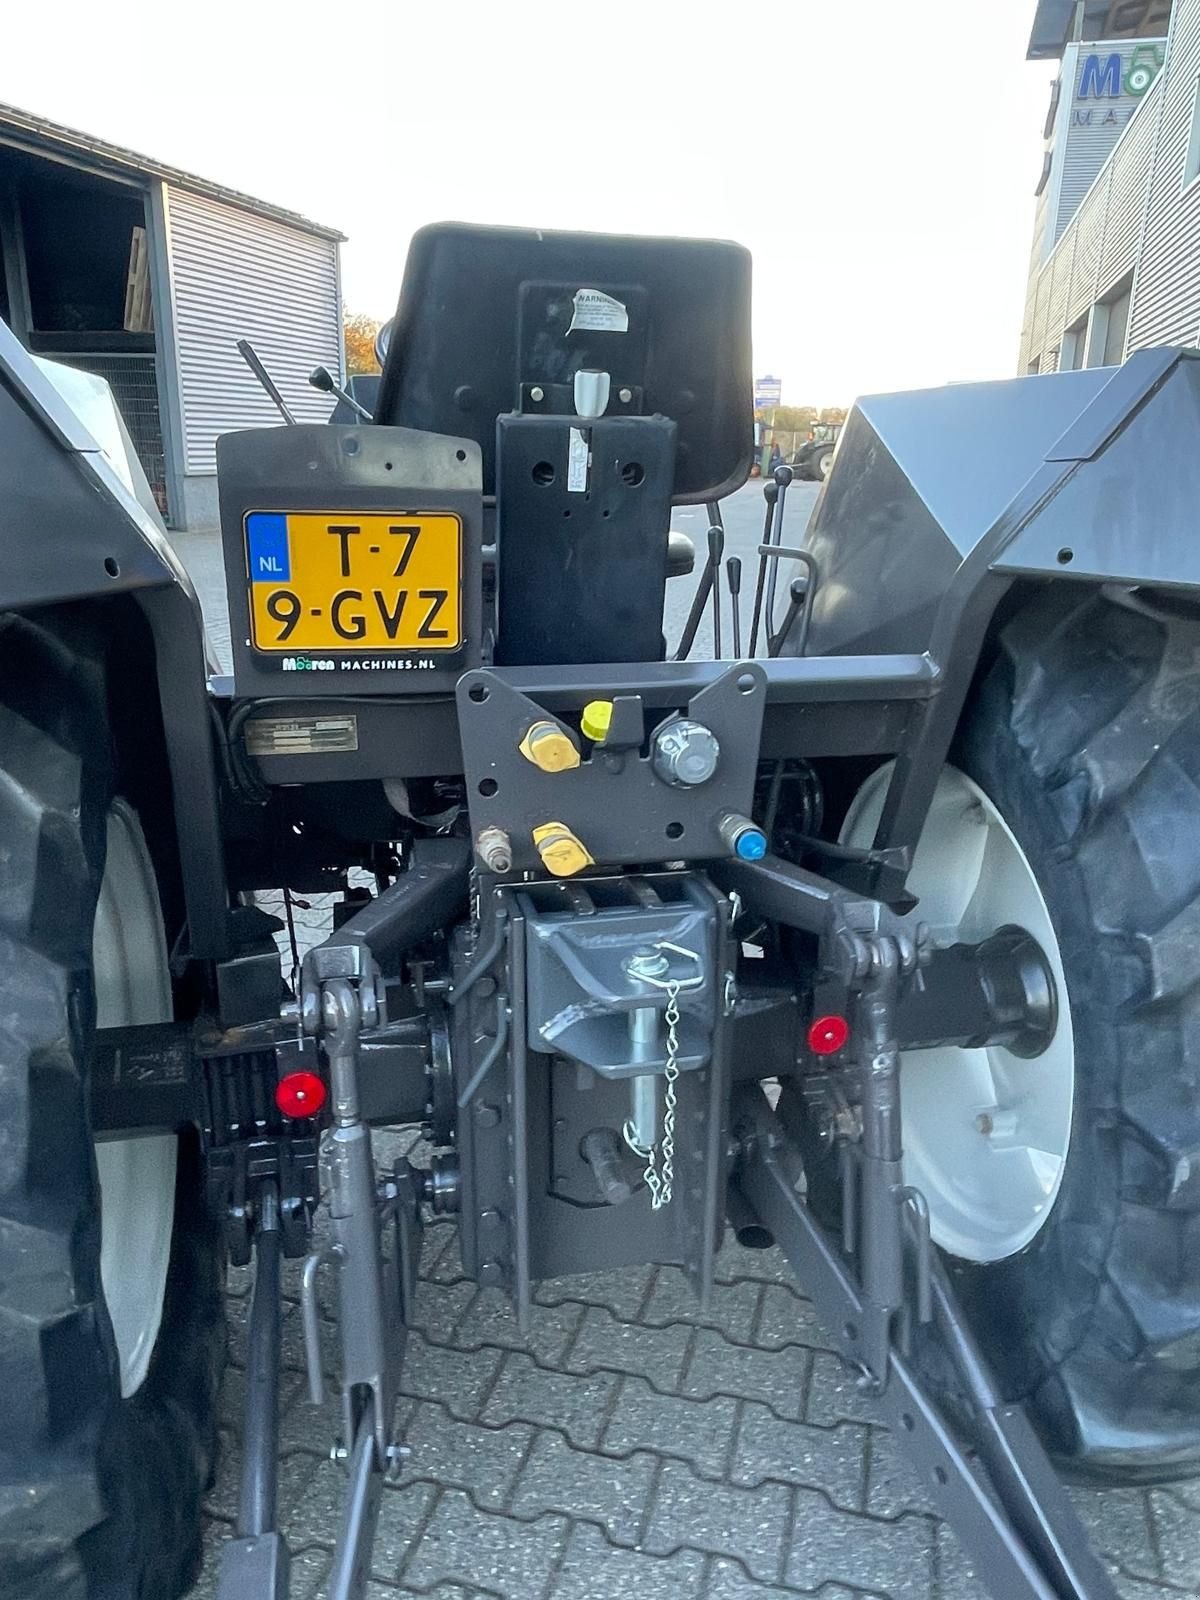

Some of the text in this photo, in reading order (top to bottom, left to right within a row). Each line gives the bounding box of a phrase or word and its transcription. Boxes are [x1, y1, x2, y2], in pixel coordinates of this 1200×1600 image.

[1072, 108, 1136, 126] MA
[327, 526, 422, 577] T-7
[259, 557, 283, 572] NL
[266, 590, 449, 641] 9-GVZ
[341, 660, 436, 670] MACHINES.NL
